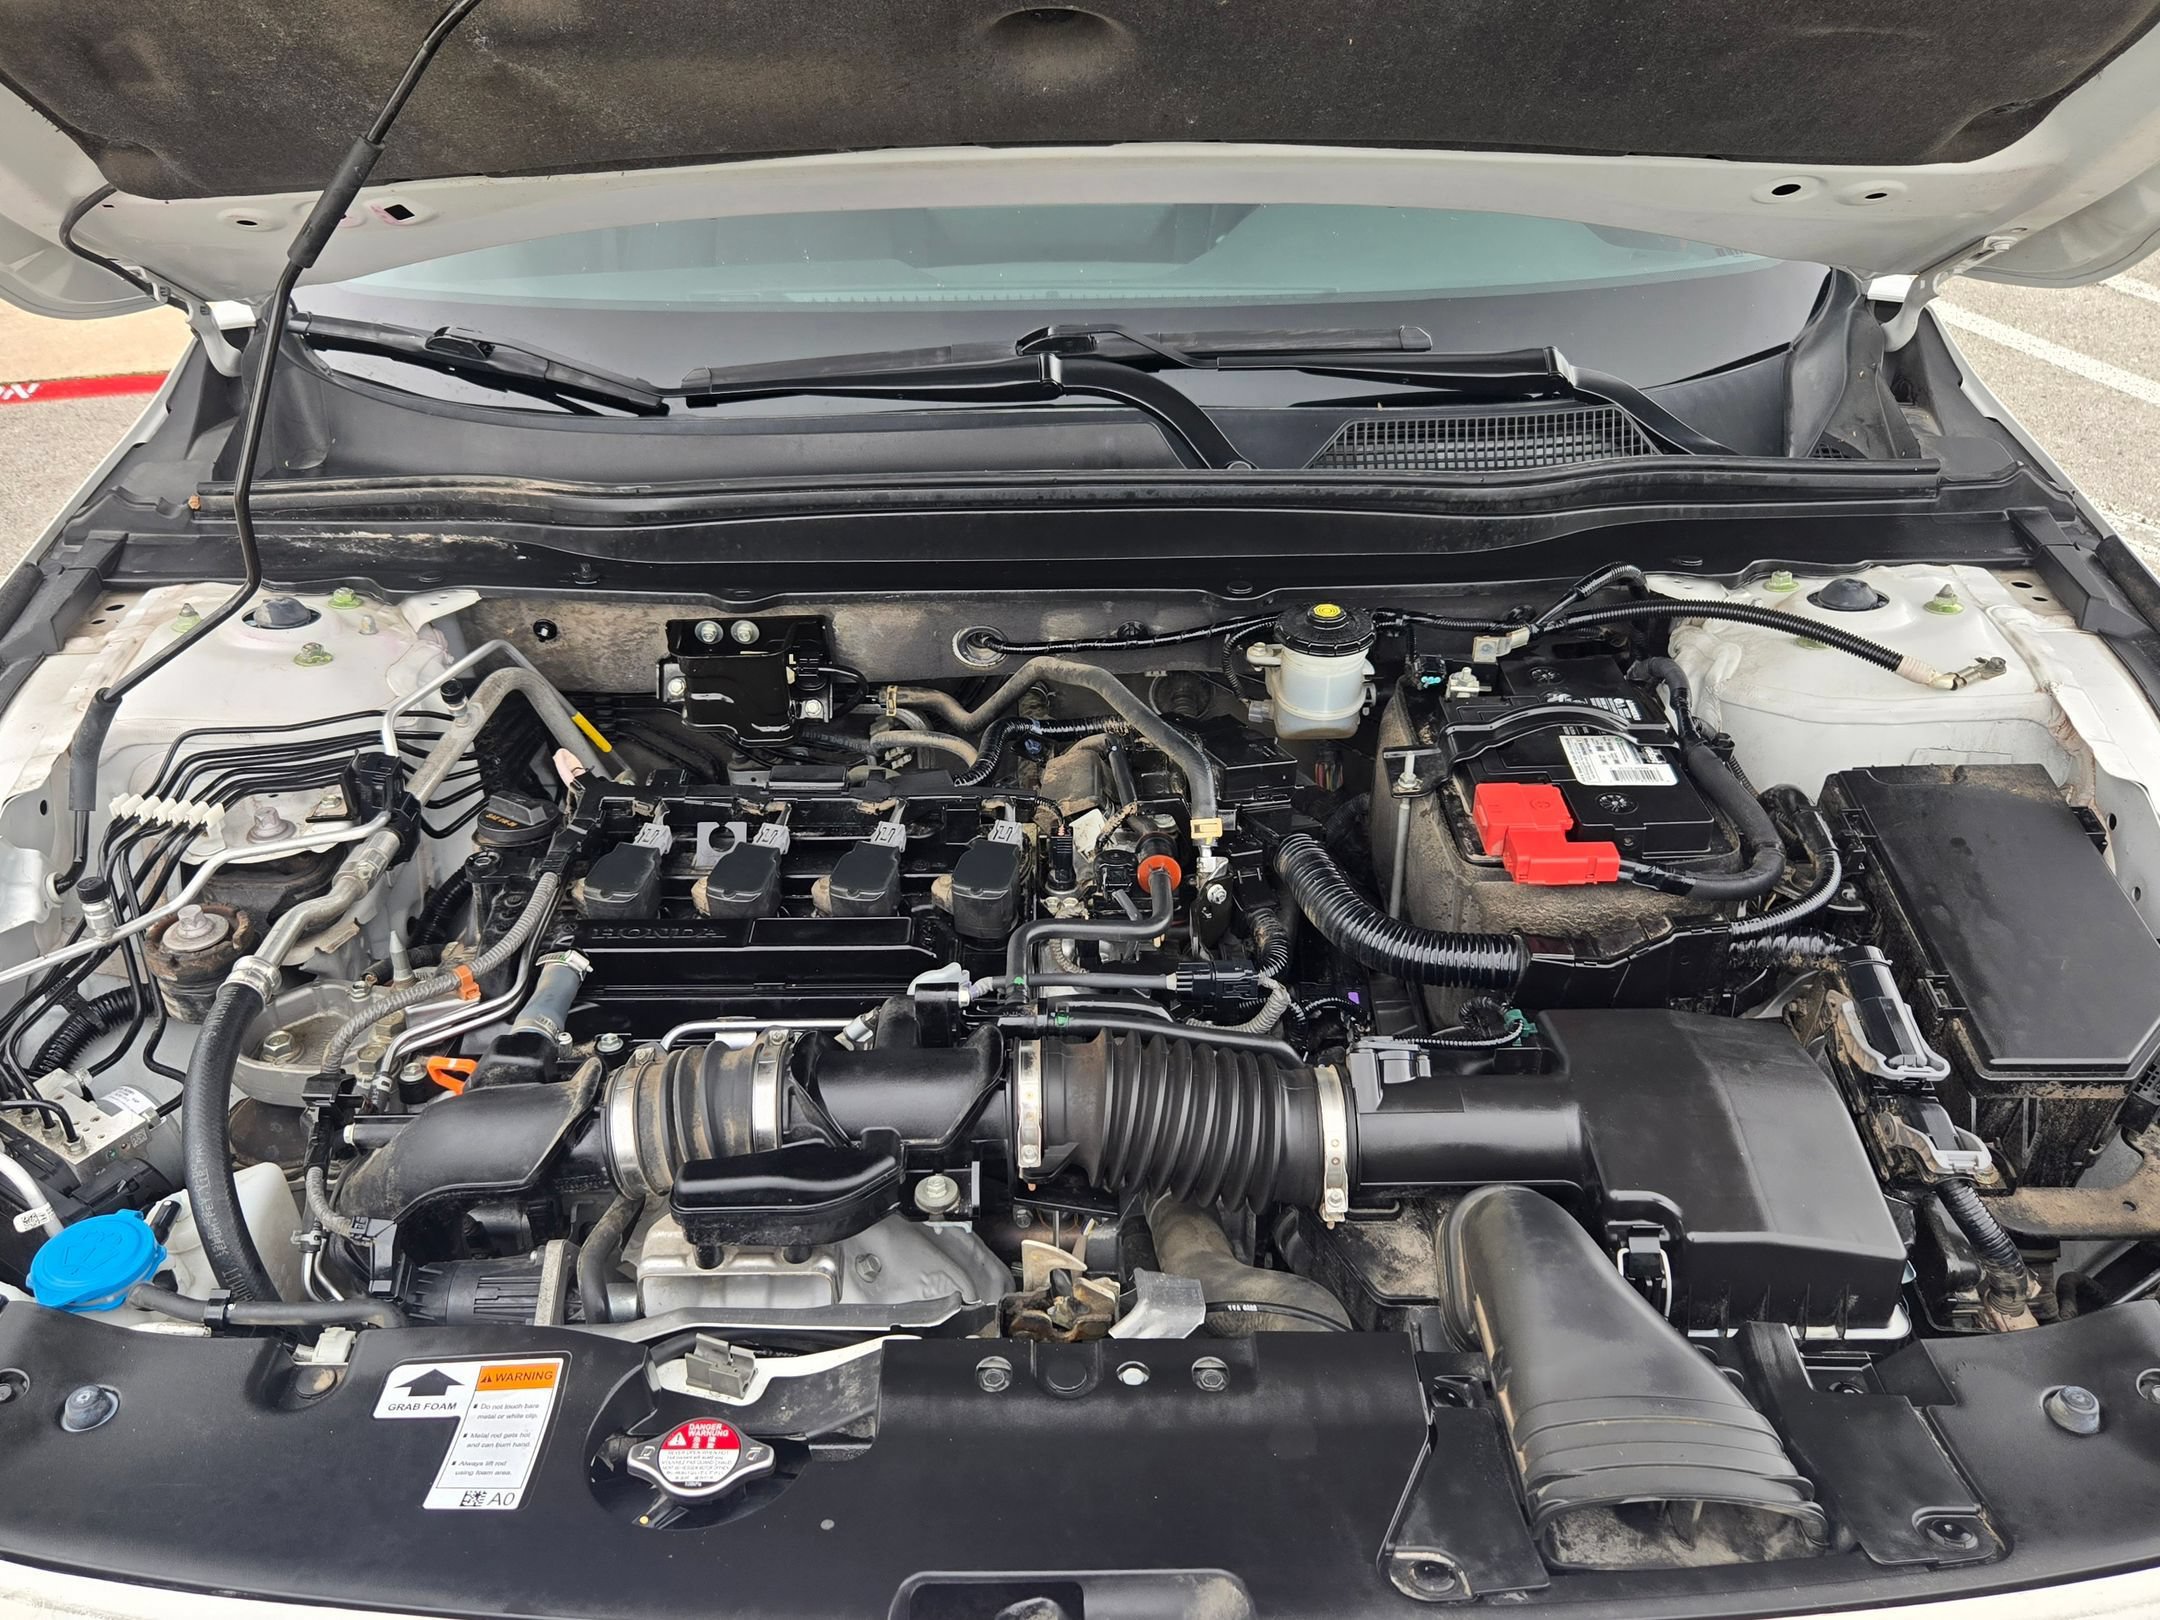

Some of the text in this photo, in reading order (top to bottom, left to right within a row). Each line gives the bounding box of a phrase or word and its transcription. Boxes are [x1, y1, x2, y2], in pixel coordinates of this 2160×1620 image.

[591, 927, 727, 939] HONDA
[495, 1371, 553, 1382] WARNING
[388, 1402, 458, 1412] GRAB FOAM
[486, 1492, 516, 1506] A0
